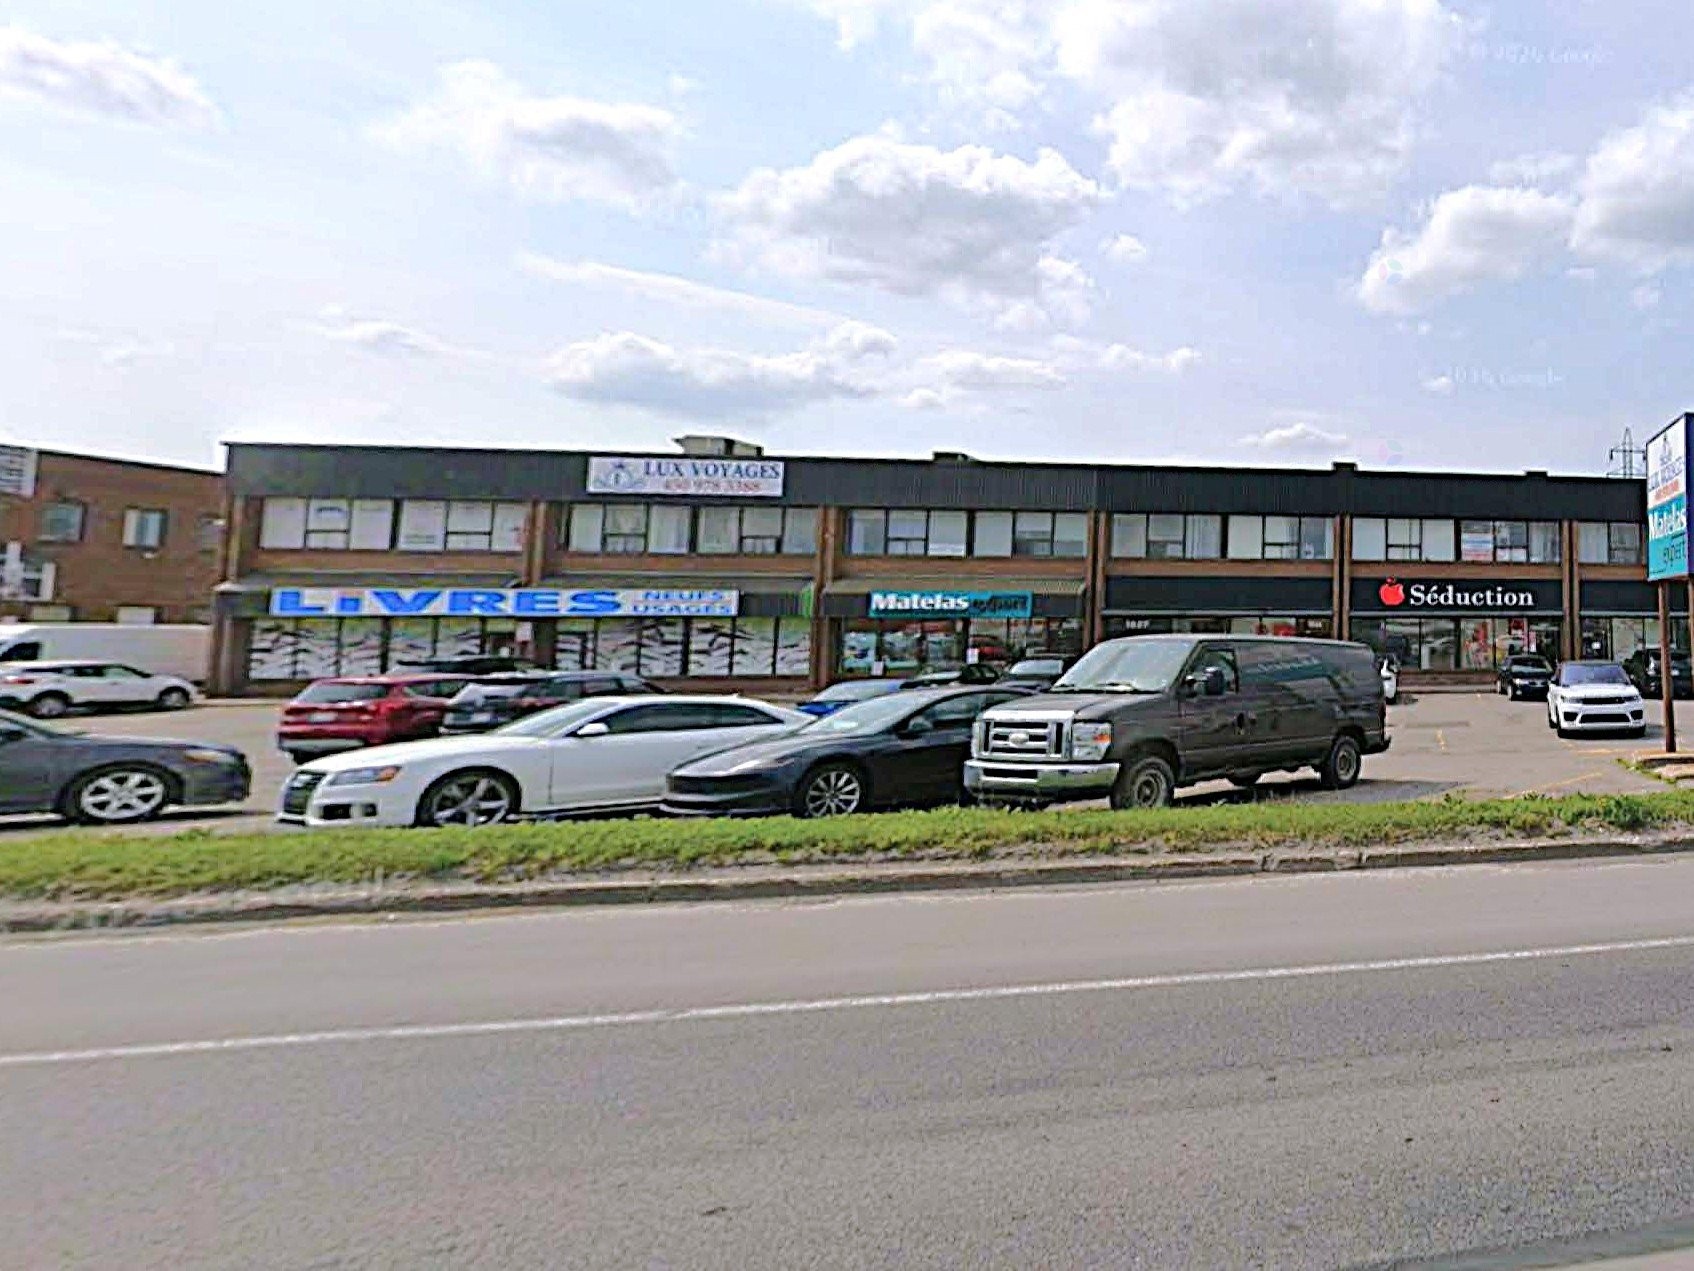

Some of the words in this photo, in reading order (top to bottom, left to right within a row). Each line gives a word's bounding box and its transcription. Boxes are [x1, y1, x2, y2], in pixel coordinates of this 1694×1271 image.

[644, 461, 684, 477] LUX
[689, 463, 780, 479] VOYAGES
[871, 593, 970, 610] Matelas
[1410, 584, 1534, 606] Séduction
